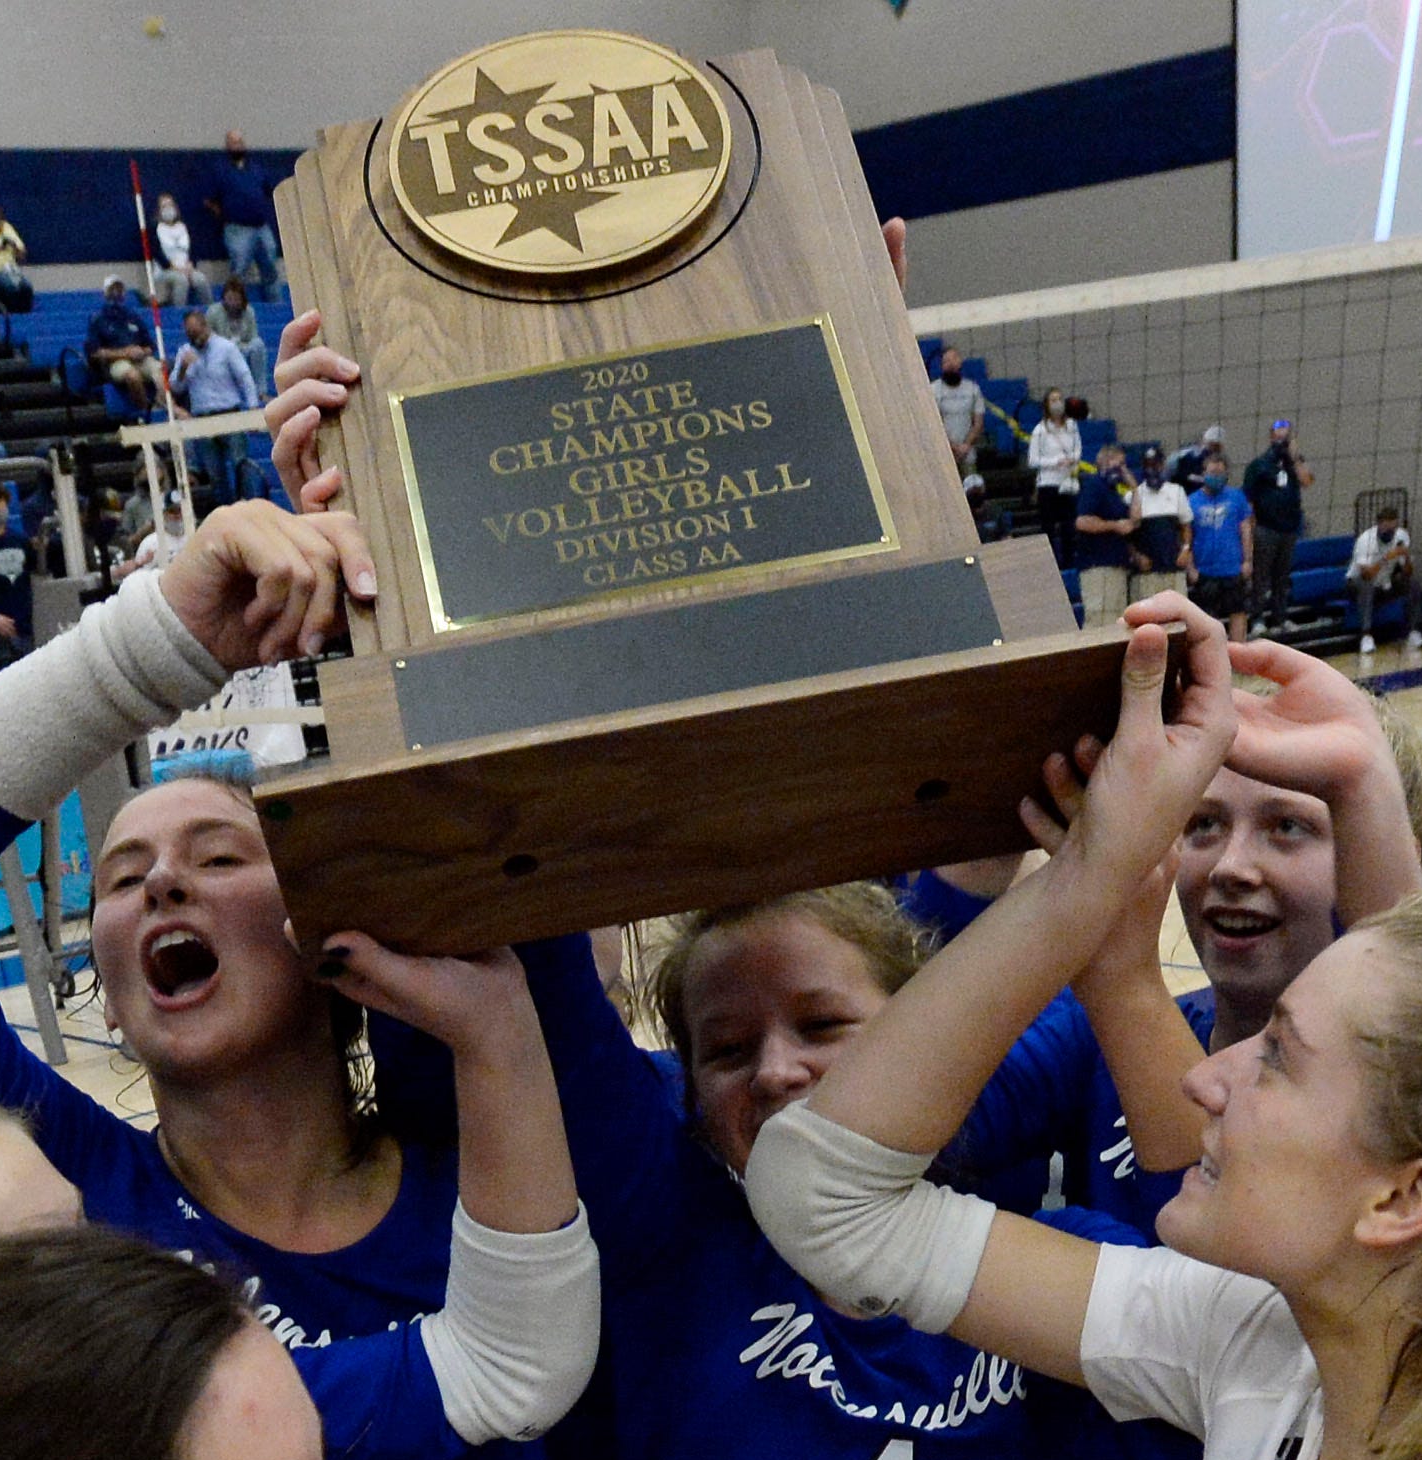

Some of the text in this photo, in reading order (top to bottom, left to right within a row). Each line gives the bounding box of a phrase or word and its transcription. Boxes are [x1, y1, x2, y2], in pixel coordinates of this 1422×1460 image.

[408, 82, 709, 195] TSSAA
[467, 159, 672, 208] CHAMPIONSHIPS
[580, 362, 649, 391] 2020
[550, 380, 697, 431] STATE
[489, 401, 773, 475] CHAMPIONS
[569, 447, 710, 496] GIRLS
[482, 463, 811, 545] VOLLEYBALL
[553, 506, 757, 563] DIVISION I
[583, 541, 743, 586] CLASS AA
